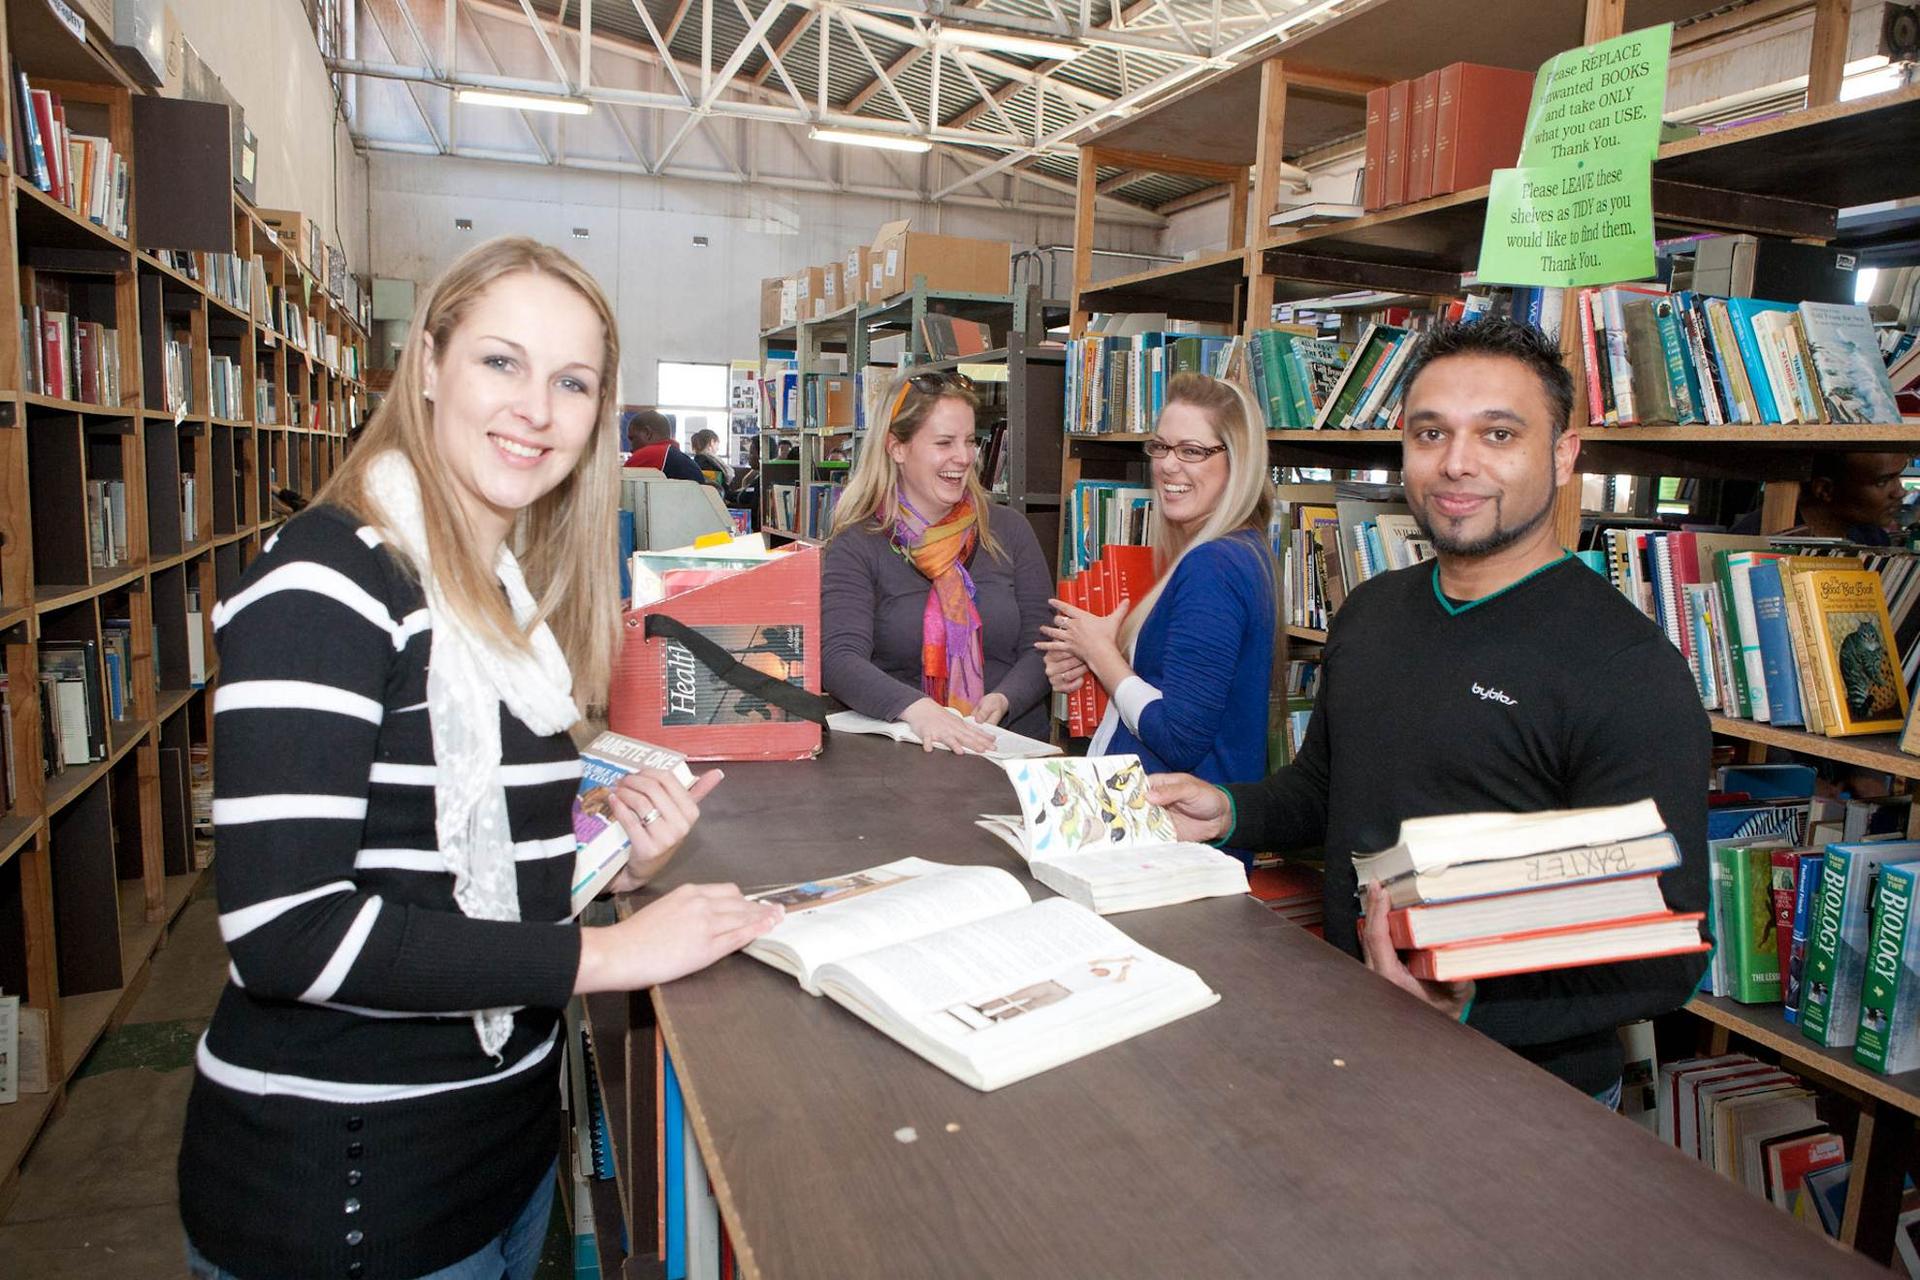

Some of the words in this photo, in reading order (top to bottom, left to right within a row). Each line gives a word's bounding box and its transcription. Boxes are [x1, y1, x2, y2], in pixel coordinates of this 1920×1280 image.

[1581, 43, 1642, 73] REPLACE
[1601, 62, 1650, 88] BOOKS
[1544, 104, 1566, 122] and
[1569, 99, 1596, 116] take
[1598, 86, 1635, 108] ONLY
[1534, 128, 1559, 145] what
[1562, 123, 1586, 142] you
[1588, 116, 1610, 131] can
[1614, 105, 1648, 125] USE.
[1551, 139, 1590, 159] Thank
[1593, 134, 1621, 150] You.
[1521, 182, 1560, 200] Please
[1562, 171, 1594, 196] LEAVE
[1596, 168, 1623, 187] these
[1510, 206, 1554, 224] shelves
[1557, 208, 1570, 222] as
[1572, 199, 1595, 219] TIDY
[1596, 199, 1608, 213] as
[1609, 195, 1632, 216] you
[1506, 231, 1542, 248] would
[1546, 231, 1567, 248] like
[1570, 231, 1580, 245] to
[1580, 222, 1599, 242] find
[1602, 220, 1636, 239] them.
[1541, 254, 1578, 272] Thank
[1578, 252, 1602, 269] You.
[1301, 340, 1312, 348] ALL
[1313, 342, 1333, 352] ABOUT
[1305, 349, 1316, 357] THE
[1318, 350, 1333, 359] SEA
[1472, 682, 1518, 705] byblos
[591, 734, 653, 763] JANETTE
[644, 751, 681, 770] OKE
[1526, 847, 1634, 881] BAXTER
[1819, 865, 1846, 959] BIOLOGY
[1875, 886, 1908, 985] BIOLOGY
